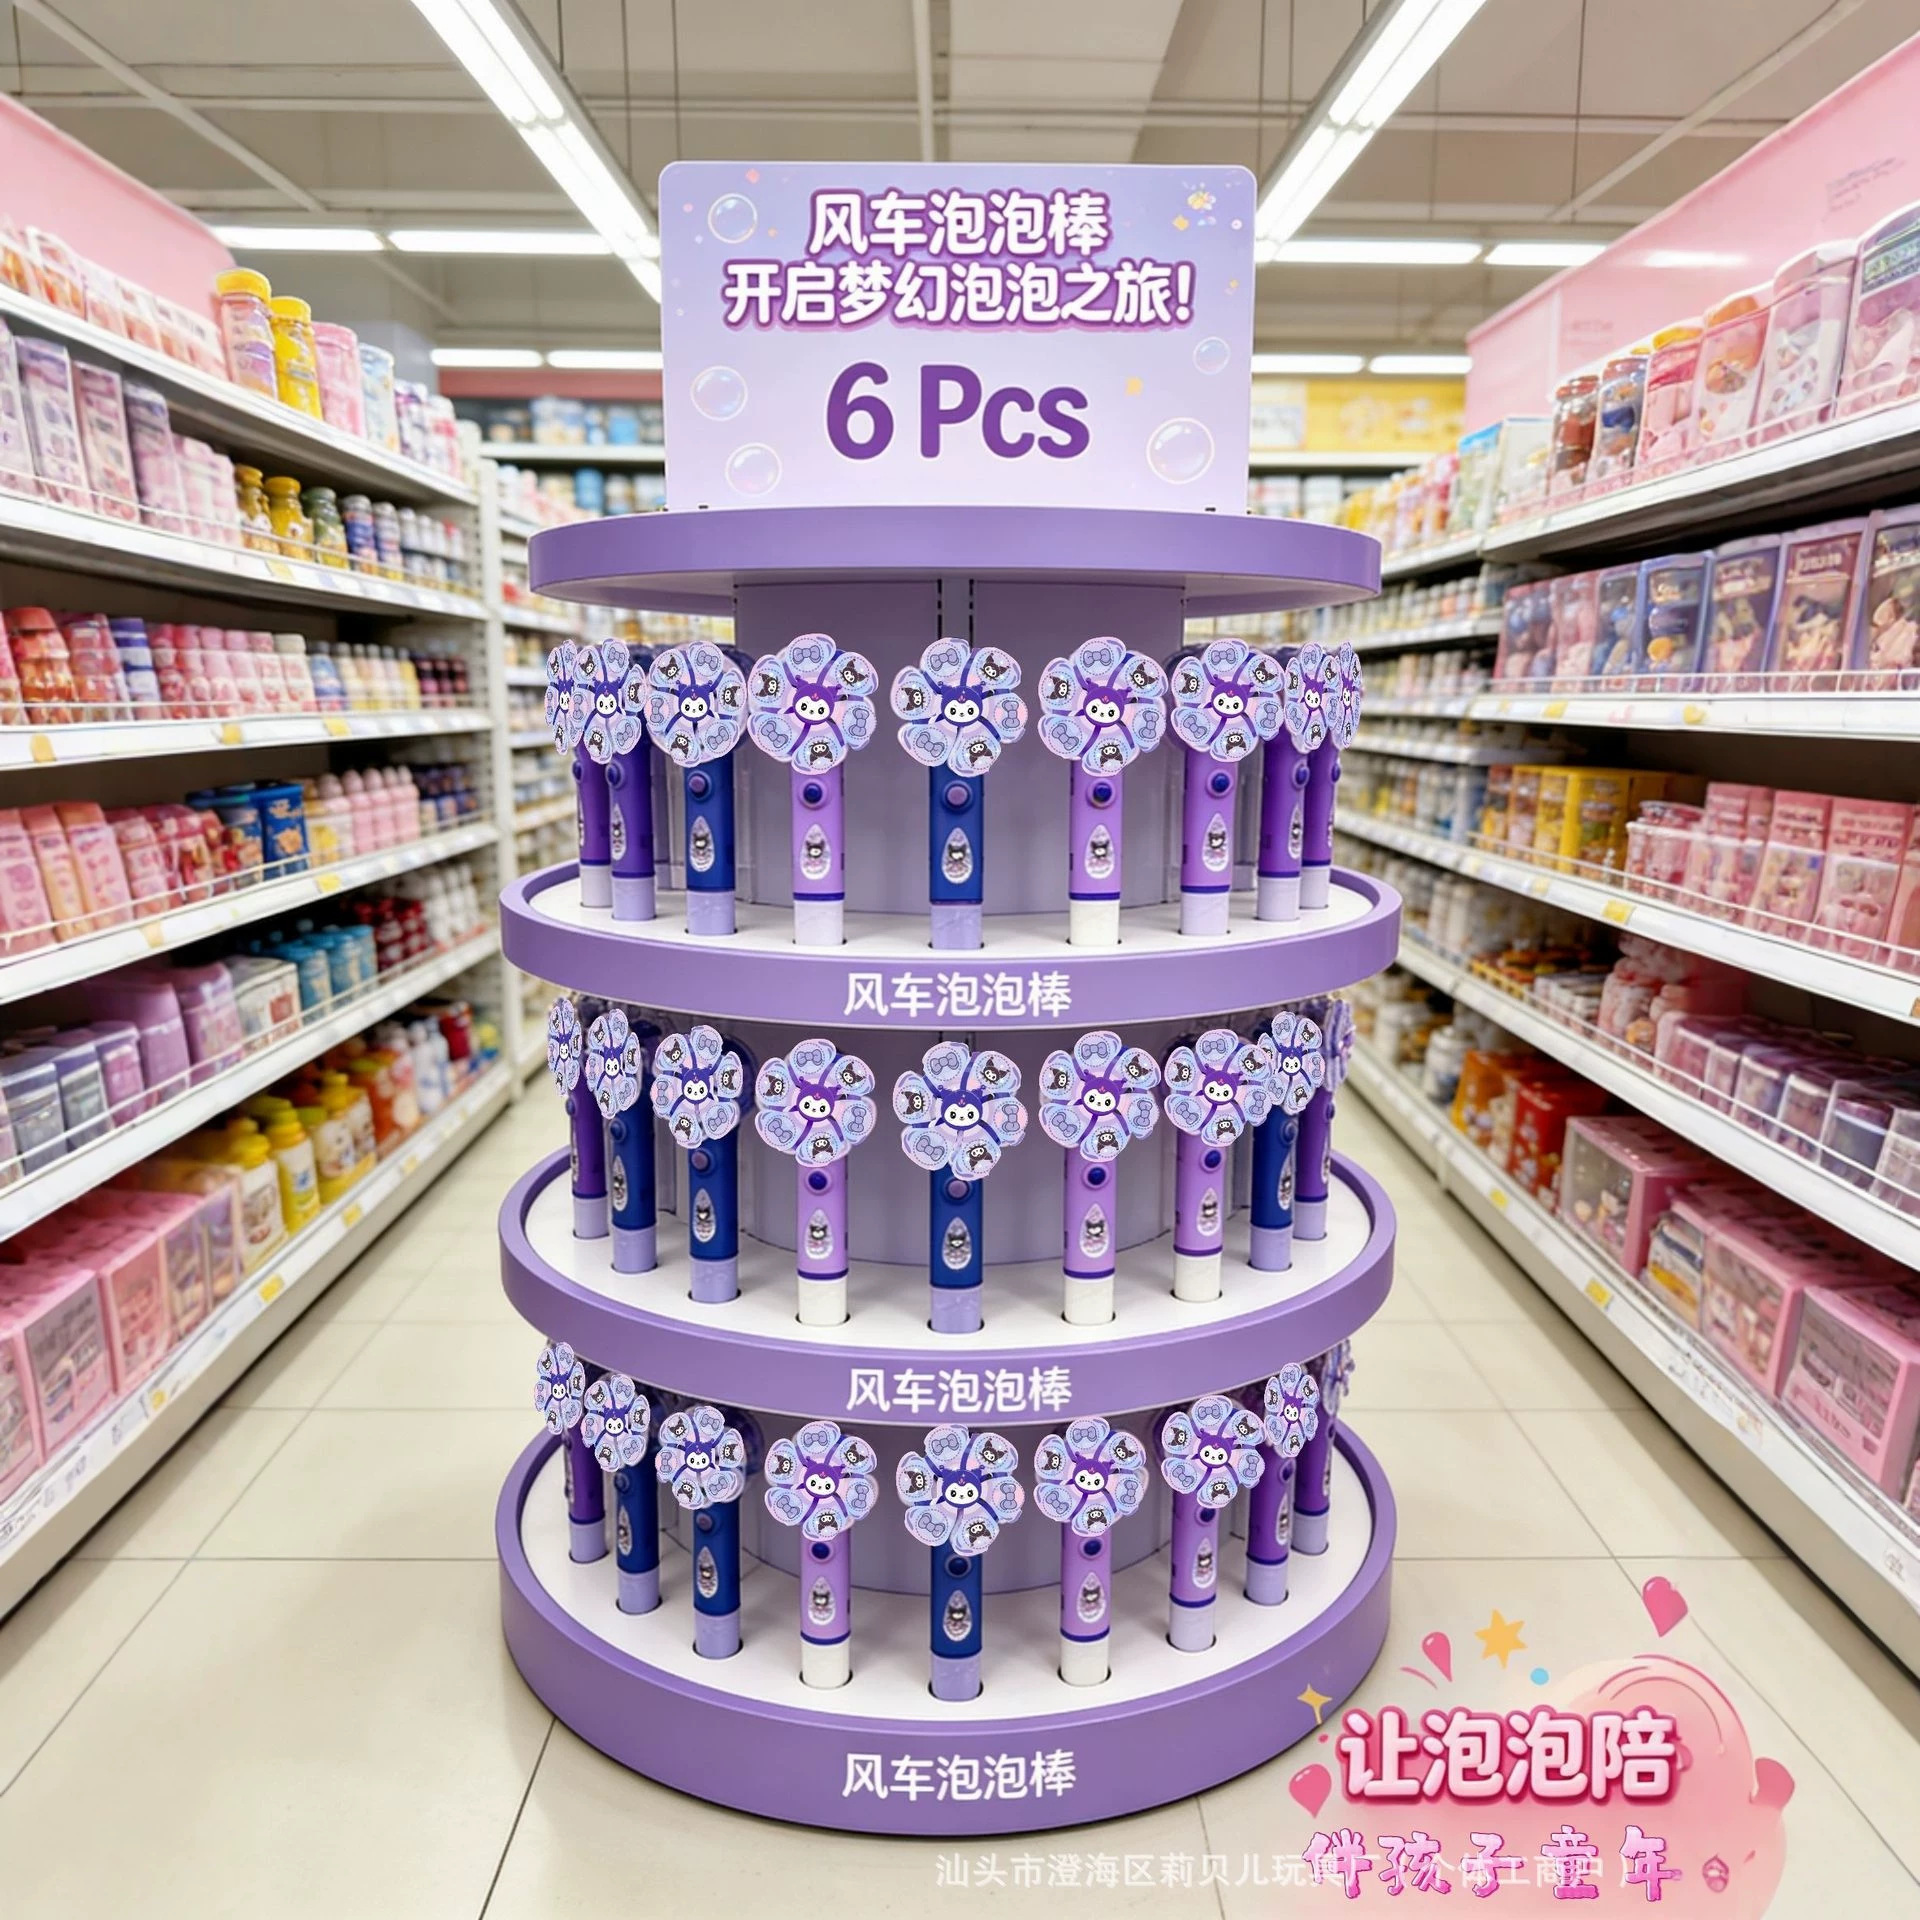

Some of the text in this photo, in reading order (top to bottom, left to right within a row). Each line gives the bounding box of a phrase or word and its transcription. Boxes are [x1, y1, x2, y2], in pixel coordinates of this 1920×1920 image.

[808, 189, 1110, 257] 风车泡泡棒
[826, 361, 1091, 460] 6 Pcs
[843, 971, 1073, 1018] 风车泡泡棒
[846, 1365, 1073, 1413] 风车泡泡棒
[842, 1748, 1077, 1801] 风车泡泡棒
